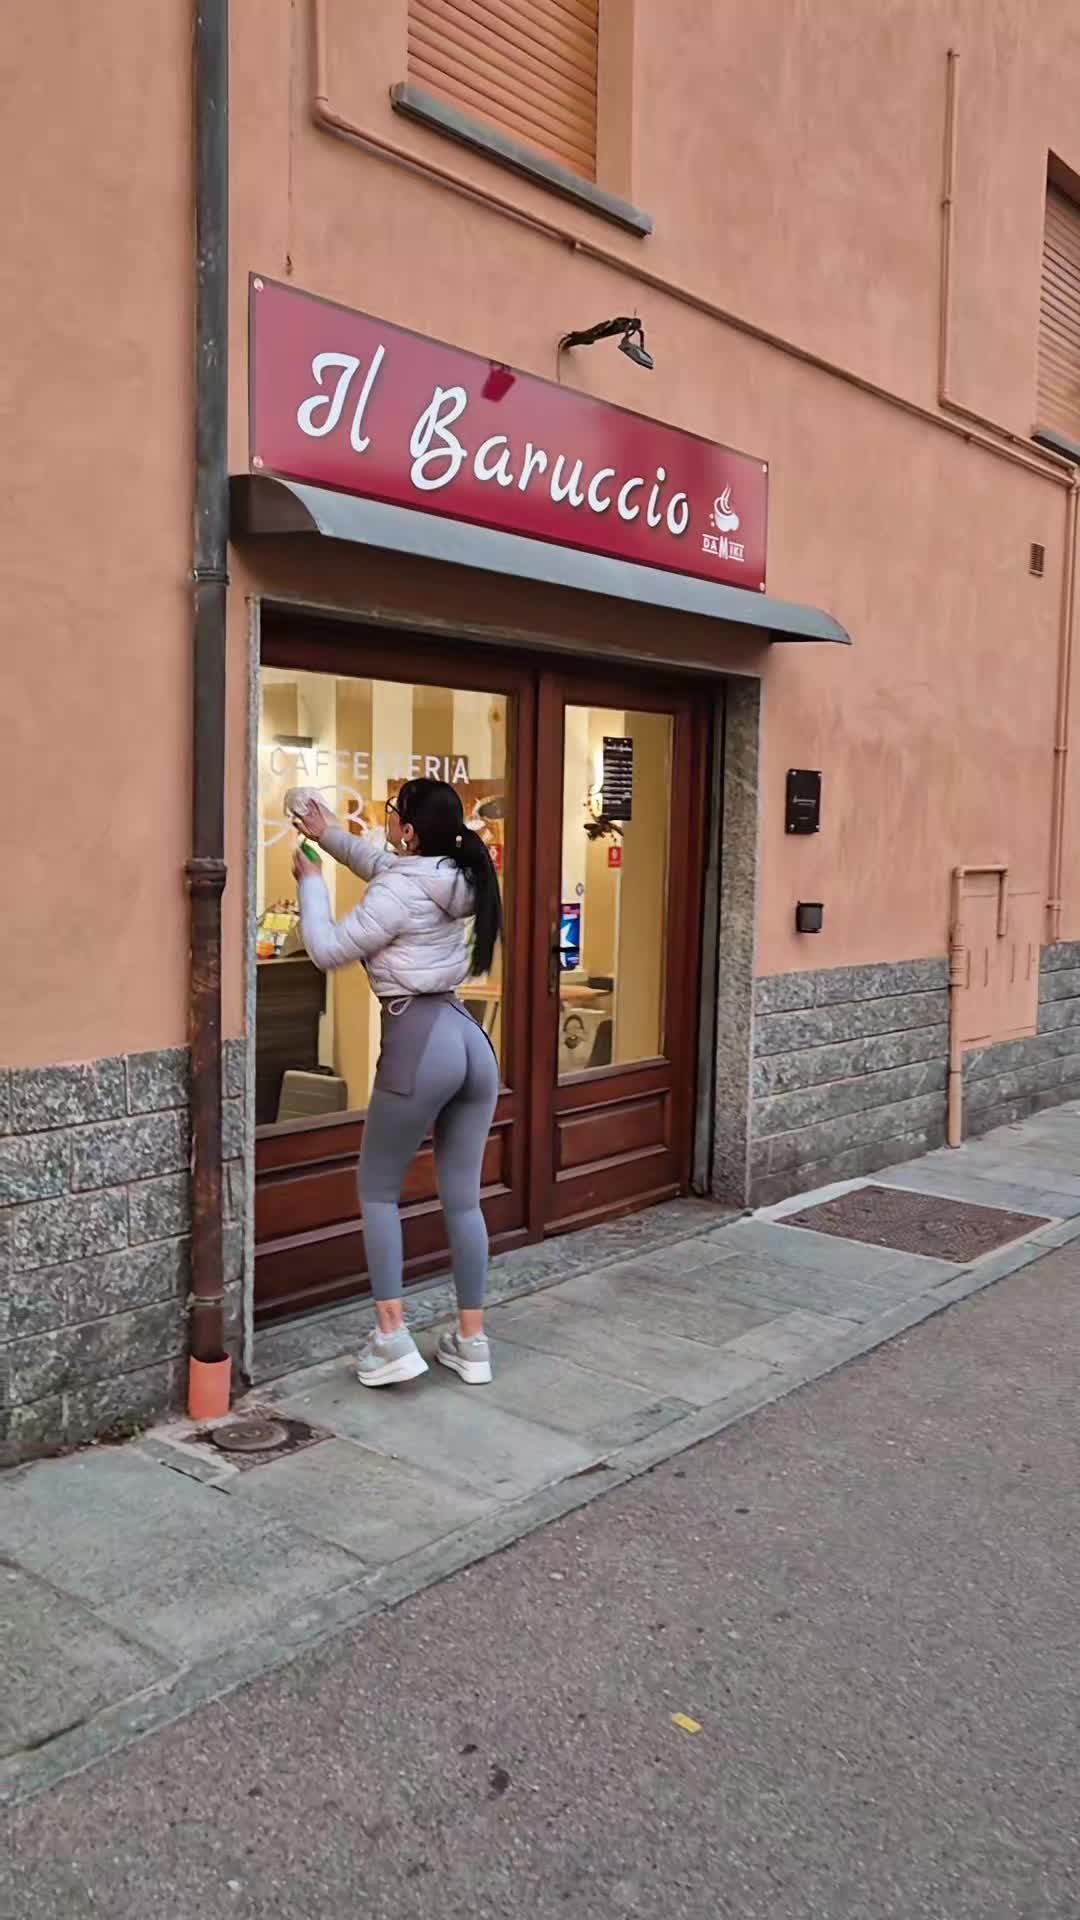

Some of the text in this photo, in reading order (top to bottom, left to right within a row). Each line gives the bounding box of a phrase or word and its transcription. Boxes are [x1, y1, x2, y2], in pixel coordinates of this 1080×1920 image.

[297, 344, 690, 536] Il Baruccio
[270, 747, 469, 784] CAFFEERIA
